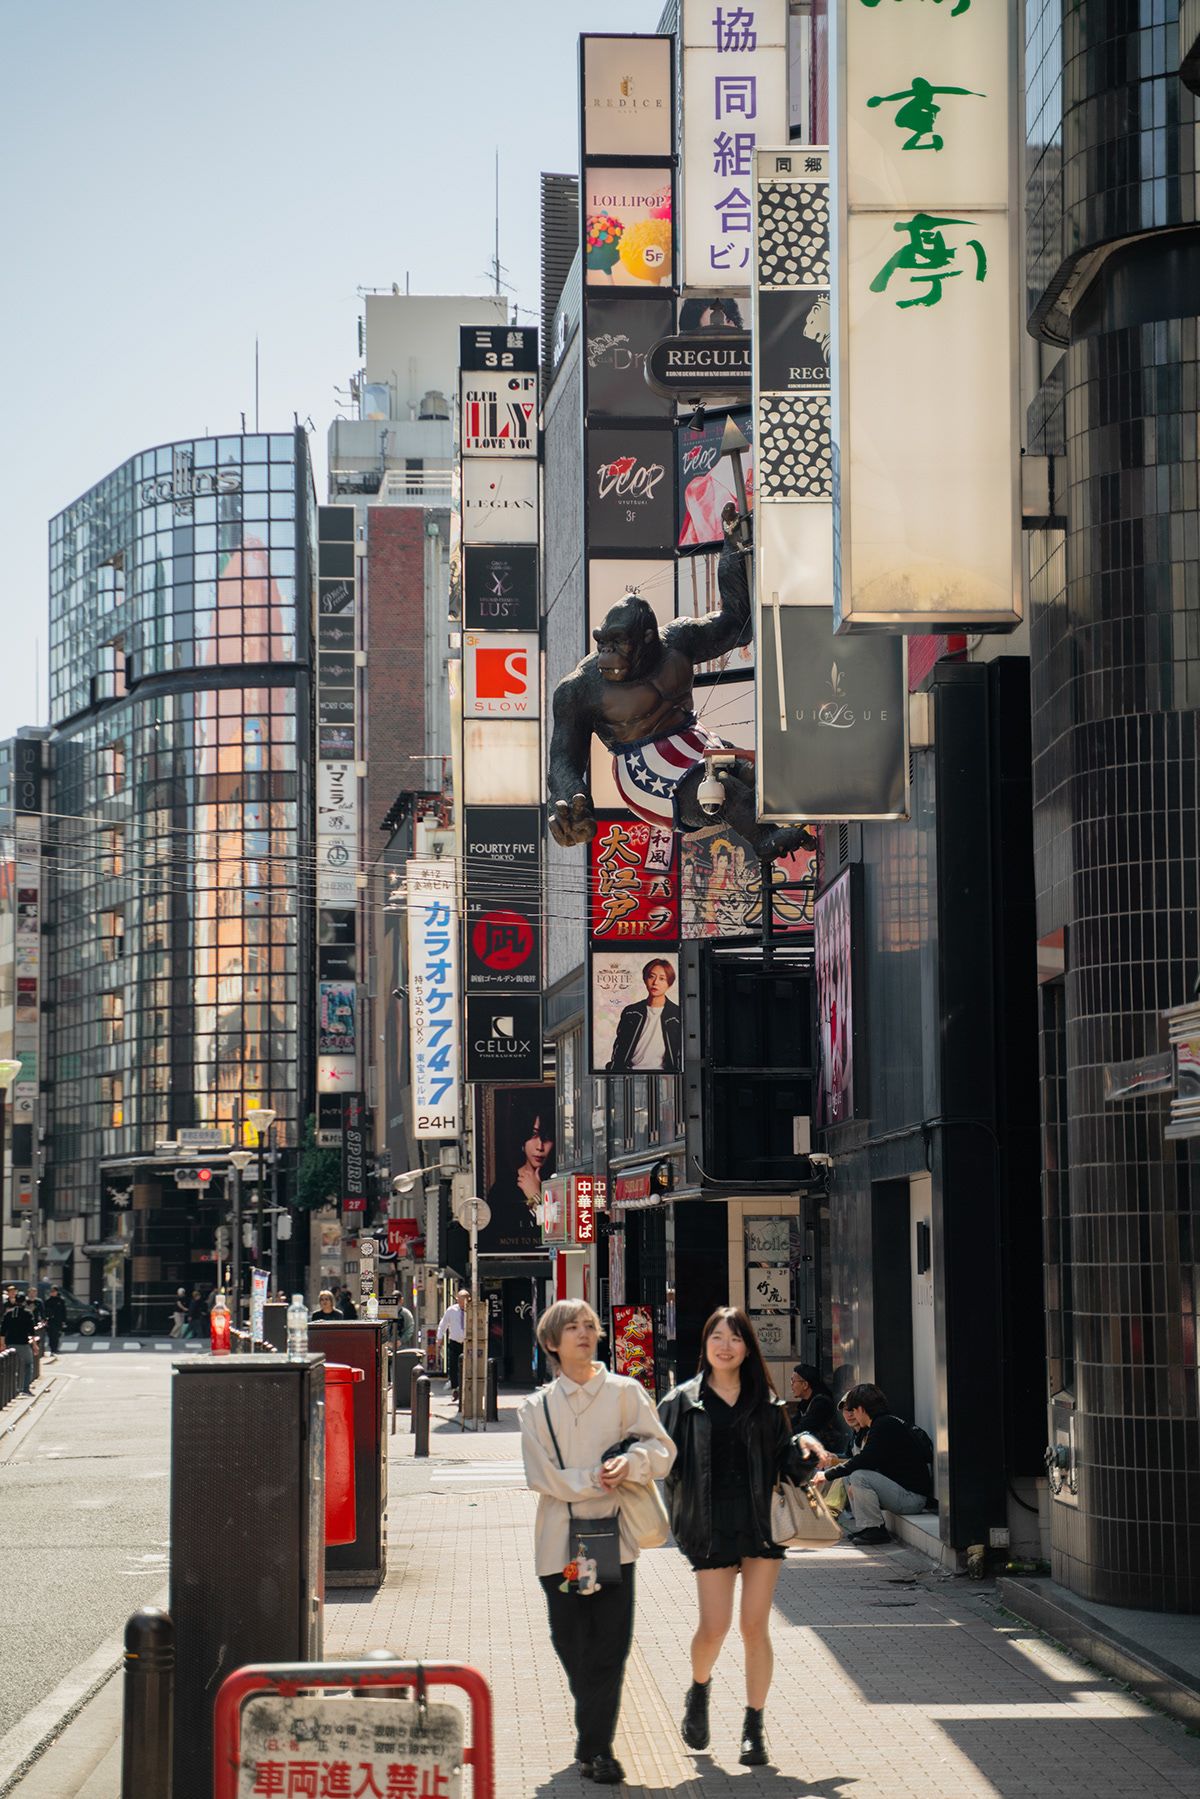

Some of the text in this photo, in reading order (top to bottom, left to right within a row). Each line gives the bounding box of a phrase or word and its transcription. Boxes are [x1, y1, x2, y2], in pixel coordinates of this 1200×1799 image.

[593, 194, 665, 208] LOLLIPOP
[645, 249, 664, 262] 5F
[485, 352, 515, 367] 32
[508, 378, 535, 391] 6F
[466, 391, 497, 402] CLUB
[475, 438, 506, 449] LOVE
[509, 438, 533, 449] YOU
[626, 510, 637, 522] 3F
[466, 636, 480, 646] 3F
[474, 702, 527, 712] SLOW
[470, 843, 535, 854] FOURTY FIVE
[648, 830, 670, 867] 和風
[594, 824, 642, 936] 大江戸
[648, 878, 673, 932] パブ
[474, 1040, 531, 1053] CELUX
[418, 1115, 456, 1129] 24H
[347, 1130, 362, 1193] SPIRE
[348, 1201, 361, 1210] 2F
[577, 1180, 593, 1239] 中華そば
[252, 1760, 450, 1799] 車両進入禁止
